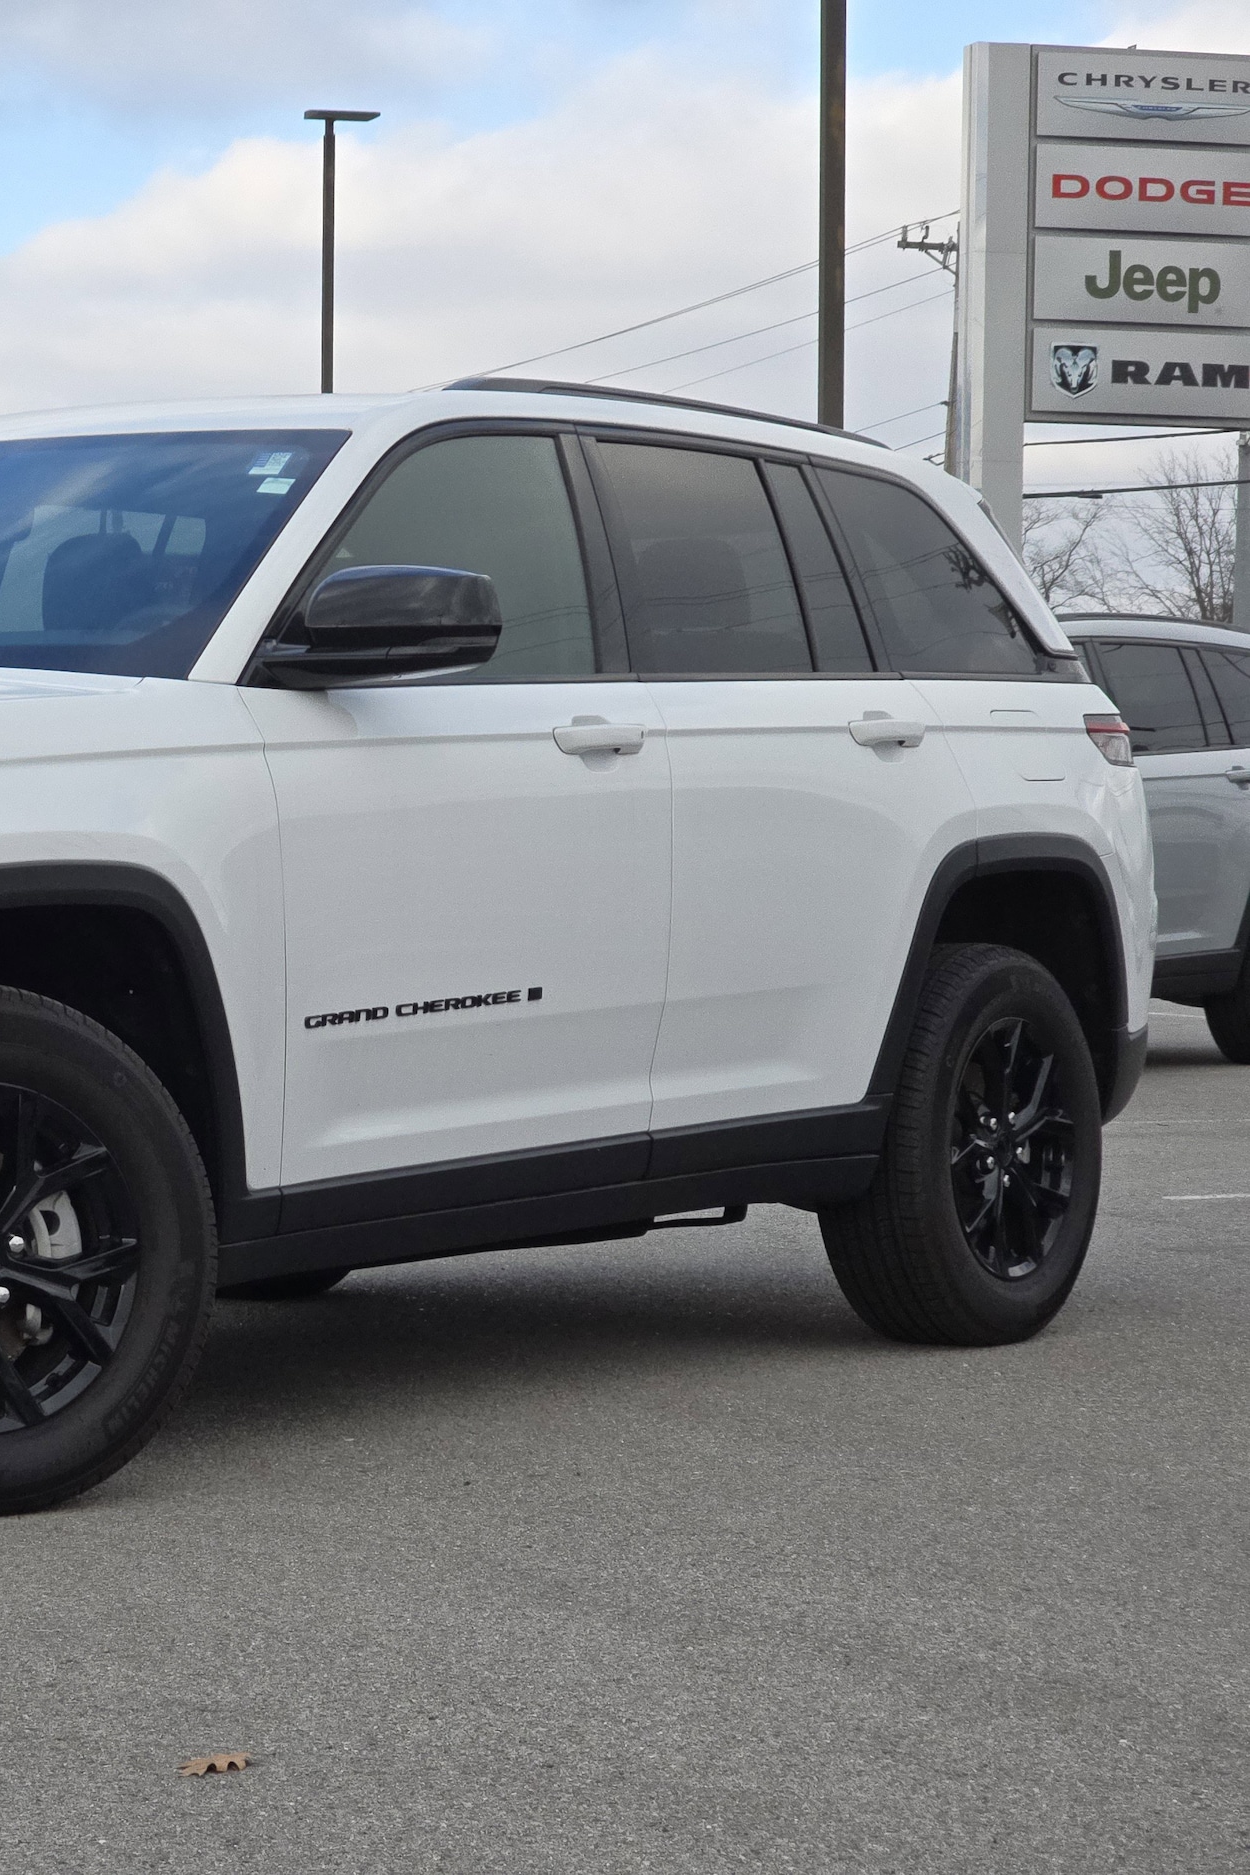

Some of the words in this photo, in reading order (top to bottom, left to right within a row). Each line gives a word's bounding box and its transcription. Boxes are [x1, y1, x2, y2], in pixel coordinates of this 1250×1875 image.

[1057, 72, 1250, 94] CHRYSLER
[1052, 173, 1250, 206] DODGE
[1085, 250, 1221, 313] Jeep
[1111, 359, 1250, 389] RAM
[304, 1006, 389, 1029] GRAND
[395, 989, 522, 1017] CHEROKEE
[107, 1320, 181, 1434] MICHELIN
